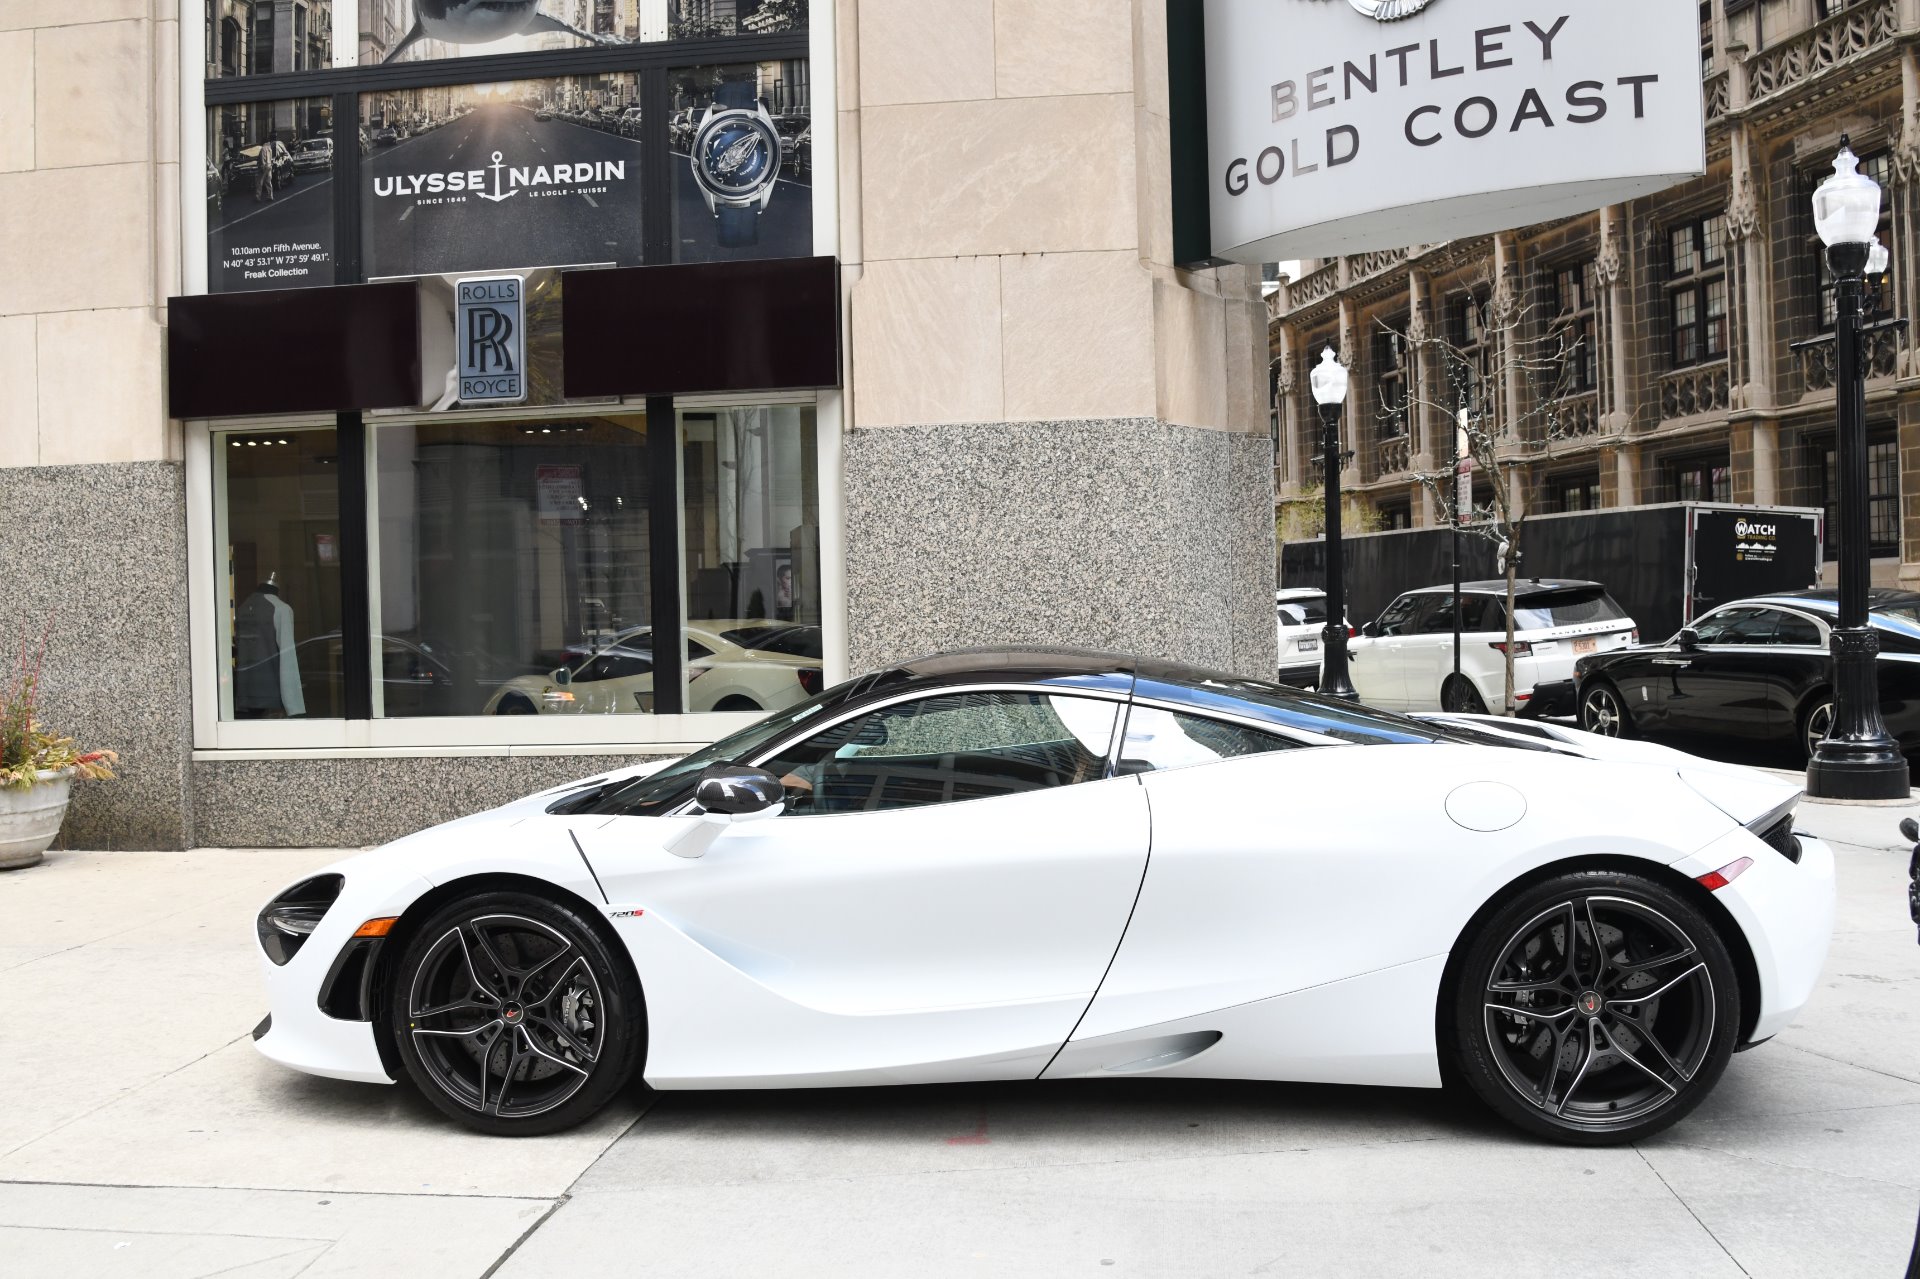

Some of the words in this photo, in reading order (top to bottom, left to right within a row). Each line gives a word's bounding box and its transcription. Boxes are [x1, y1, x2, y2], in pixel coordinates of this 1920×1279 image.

[1271, 15, 1570, 123] BENTLEY
[1225, 124, 1360, 196] GOLD
[1404, 74, 1659, 147] COAST
[373, 169, 485, 197] ULYSSE
[509, 160, 625, 187] NARDIN
[541, 189, 567, 197] LOCLE
[577, 186, 607, 195] SUISSE
[417, 198, 444, 206] SINCE
[231, 246, 260, 256] 10.10am
[261, 246, 272, 254] on
[273, 243, 290, 253] Fifth
[291, 242, 321, 252] Avenue.
[223, 260, 230, 268] N
[275, 256, 284, 264] W
[244, 270, 267, 279] Freak
[268, 267, 308, 278] Collection
[462, 284, 515, 300] ROLLS
[464, 379, 517, 395] ROYCE
[1735, 521, 1776, 535] WATCH
[609, 909, 645, 919] 720S
